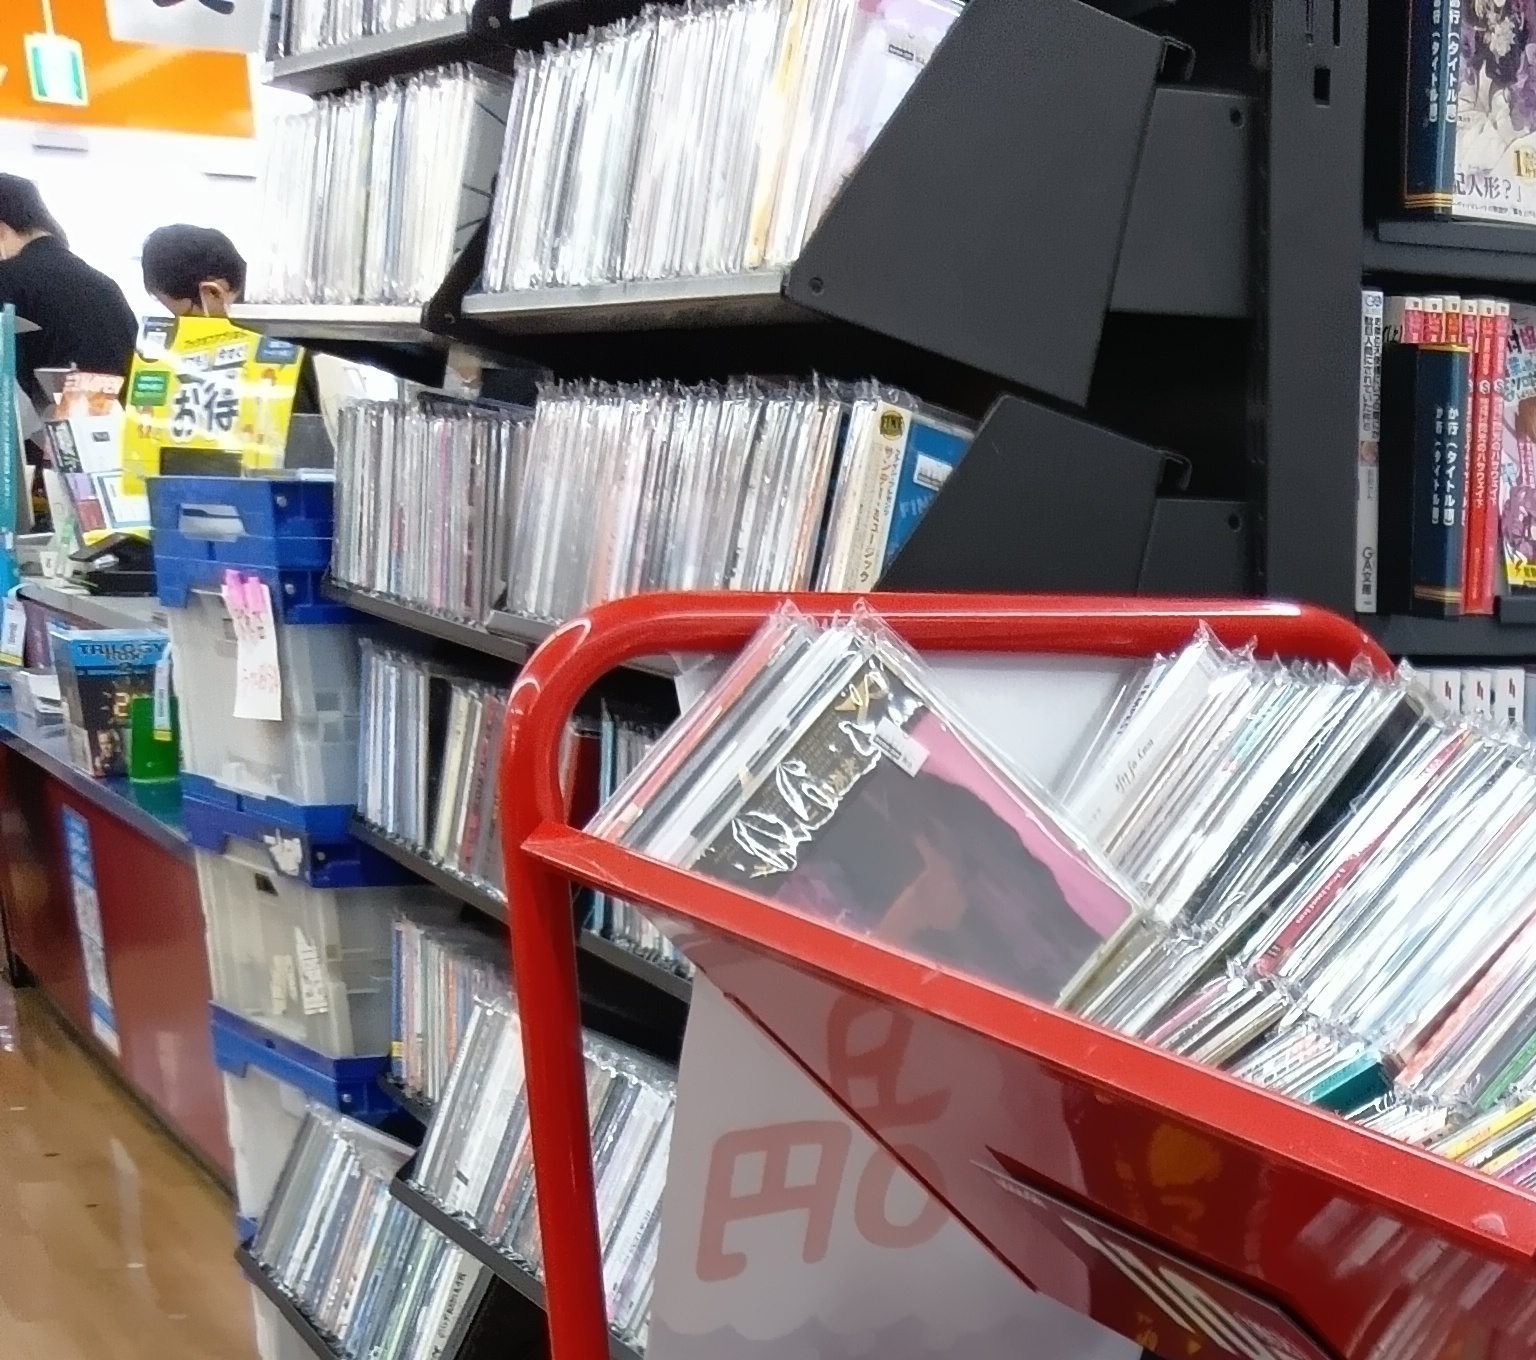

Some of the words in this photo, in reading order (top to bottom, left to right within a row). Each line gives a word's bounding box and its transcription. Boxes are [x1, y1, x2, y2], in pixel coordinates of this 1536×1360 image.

[1134, 737, 1156, 761] way
[1122, 758, 1142, 778] of
[1111, 772, 1132, 794] life
